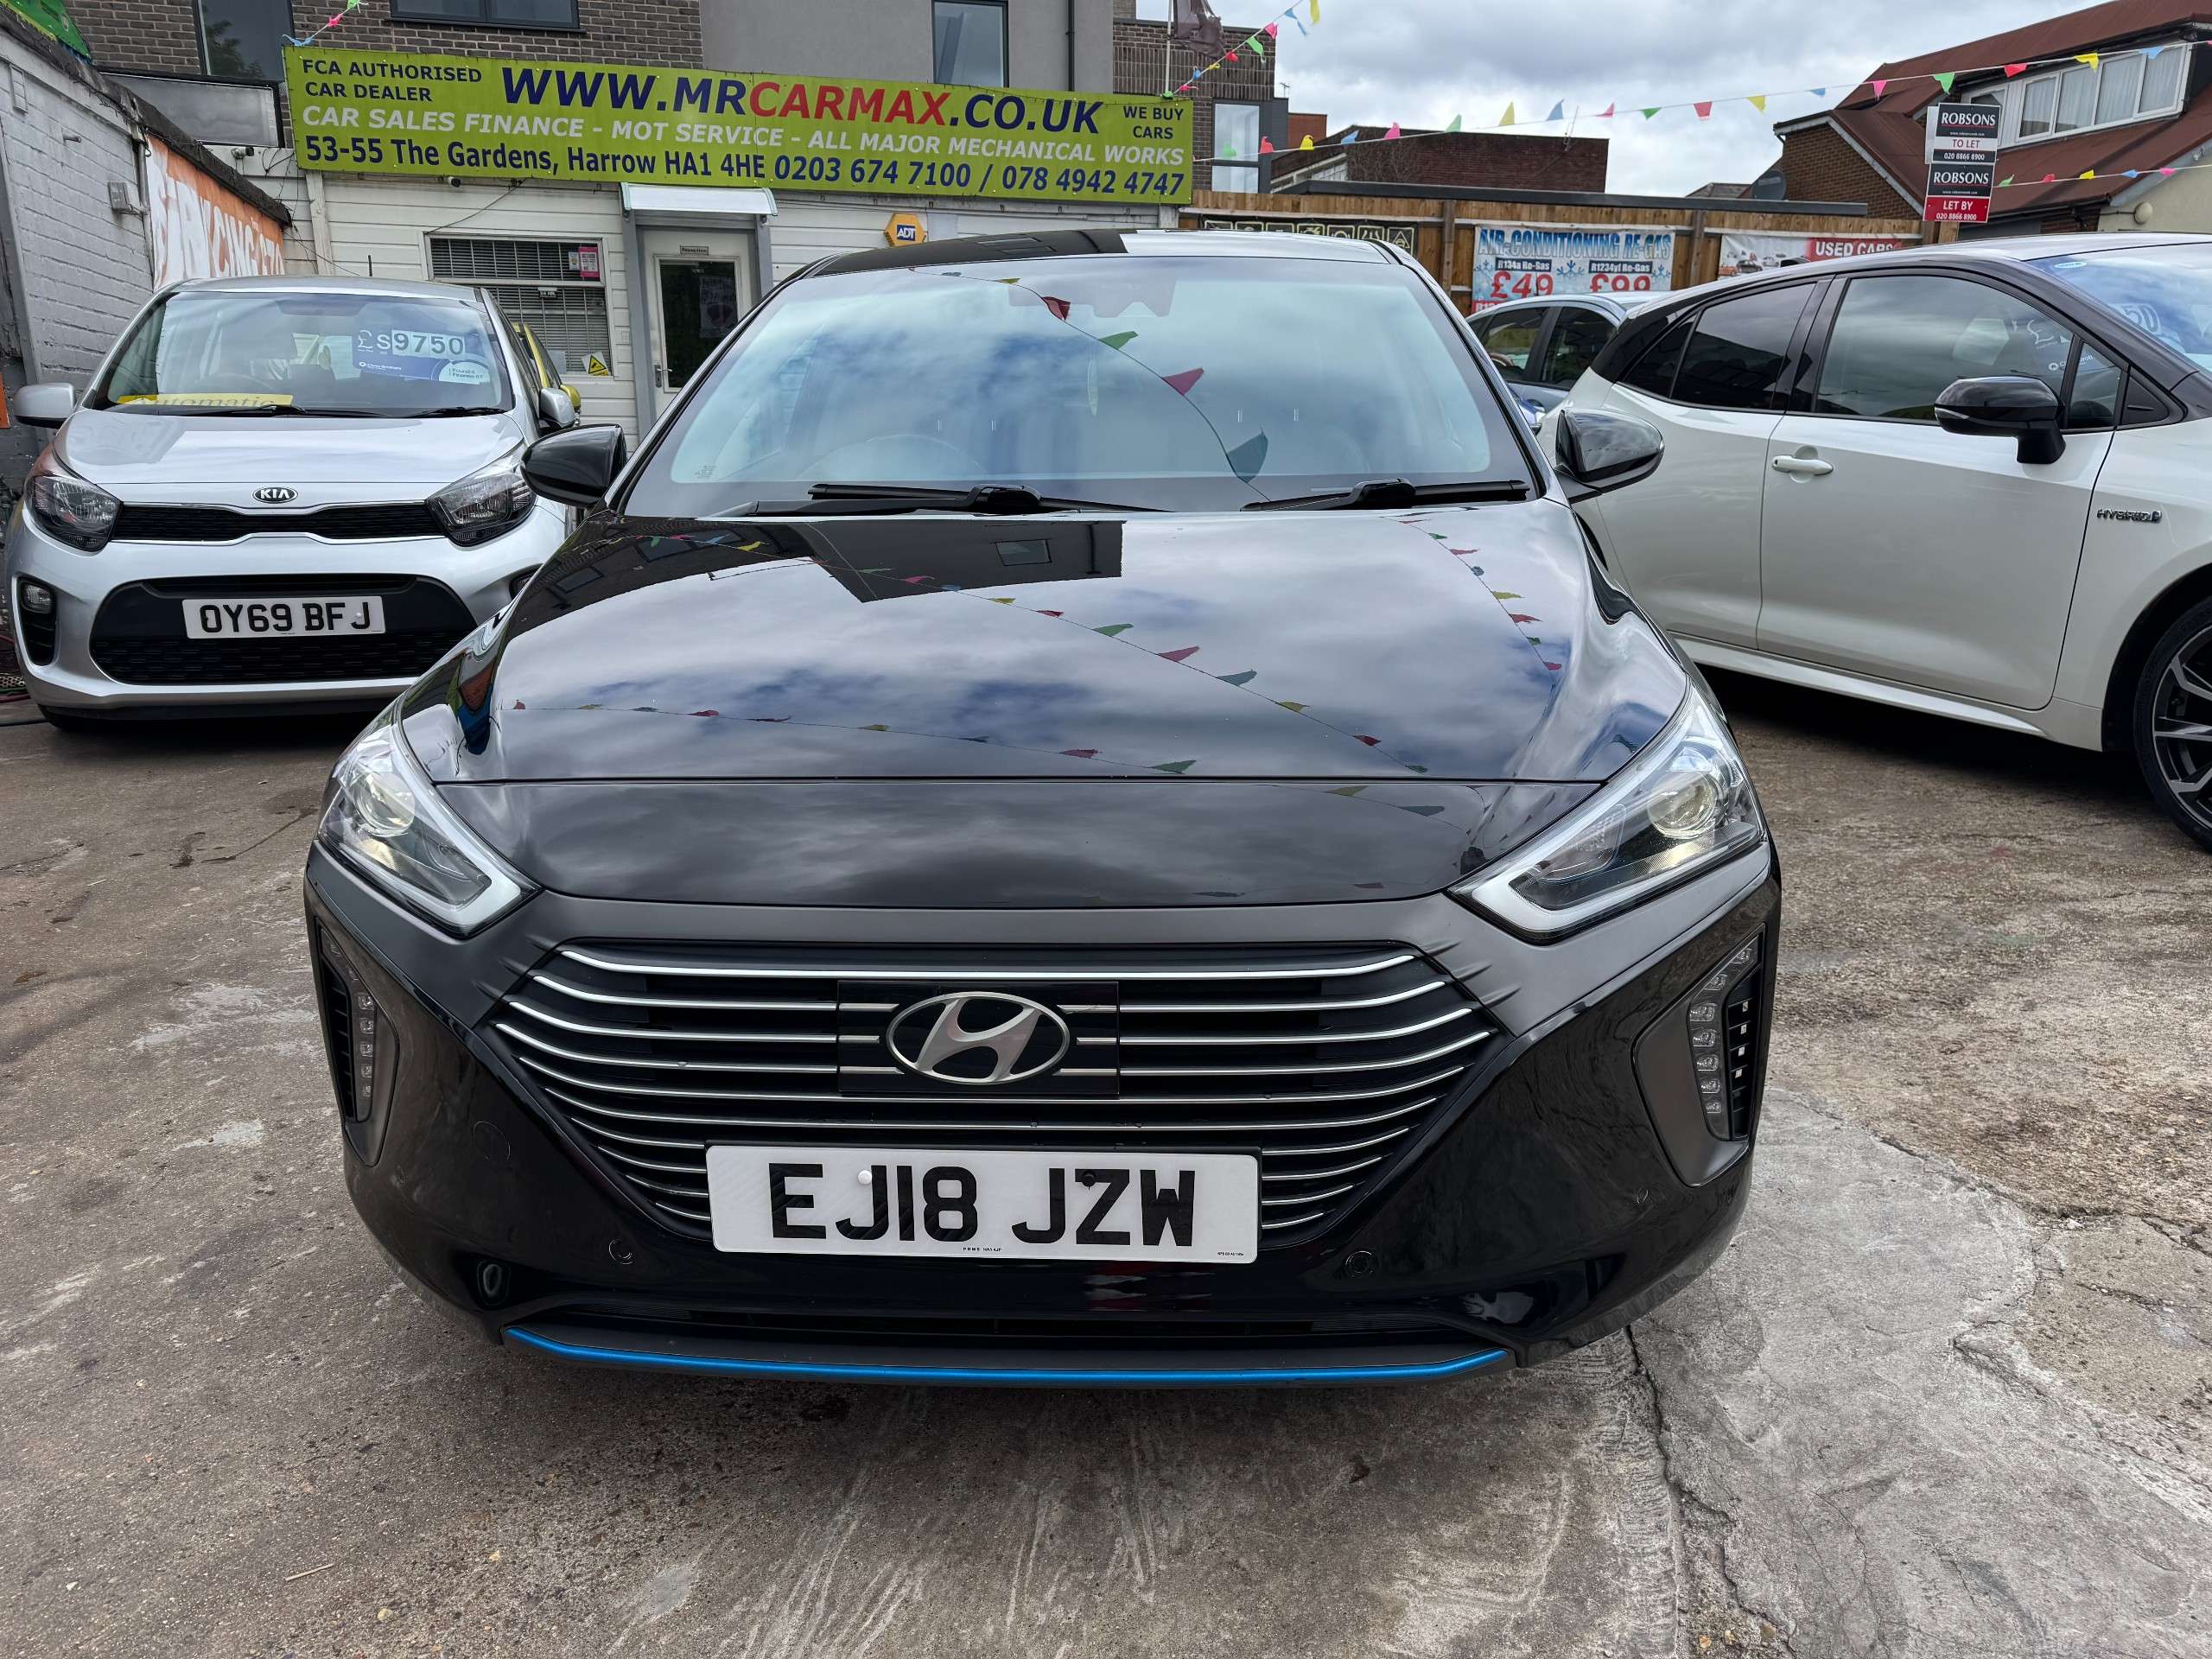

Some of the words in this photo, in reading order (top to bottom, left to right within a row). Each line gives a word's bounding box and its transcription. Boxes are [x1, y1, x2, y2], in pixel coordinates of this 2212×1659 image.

[302, 59, 342, 76] FCA
[348, 61, 482, 83] AUTHORISED
[305, 82, 347, 98] CAR
[353, 84, 433, 102] DEALER
[502, 67, 1104, 135] WWW.MRCARMAX.CO.UK
[1123, 105, 1148, 120] WE
[1153, 106, 1184, 122] BUY
[1941, 112, 1996, 126] ROBSONS
[302, 105, 359, 128] CAR
[368, 108, 455, 131] SALES
[464, 113, 583, 138] FINANCE
[611, 120, 668, 141] MOT
[676, 123, 784, 148] SERVICE
[808, 130, 851, 150] ALL
[860, 132, 940, 155] MAJOR
[948, 137, 1096, 162] MECHANICAL
[1105, 145, 1184, 166] WORKS
[1133, 124, 1173, 140] CARS
[1953, 139, 1963, 148] TO
[1966, 139, 1980, 149] LET
[305, 135, 383, 163] 53-55
[391, 139, 439, 166] The
[448, 142, 559, 175] Gardens,
[568, 147, 656, 175] Harrow
[665, 150, 711, 176] HA1
[721, 154, 766, 179] 4HE
[775, 155, 841, 182] 0203
[850, 158, 899, 184] 674
[909, 162, 971, 188] 7100
[978, 162, 993, 192] /
[1001, 165, 1048, 191] 078
[1056, 168, 1116, 194] 4942
[1124, 170, 1185, 196] 4747
[1934, 172, 1989, 184] ROBSONS
[1943, 200, 1960, 210] LET
[1961, 201, 1974, 211] BY
[897, 226, 915, 240] ADT
[1478, 229, 1620, 258] AIR-CONDITIONING
[1624, 234, 1672, 259] RE-GAS
[1815, 242, 1853, 257] USED
[1491, 270, 1554, 299] £49
[260, 489, 289, 499] KIA
[199, 603, 293, 633] OY69
[302, 601, 371, 632] BFJ
[768, 1162, 978, 1243] EJ18
[1011, 1167, 1196, 1247] JZW
